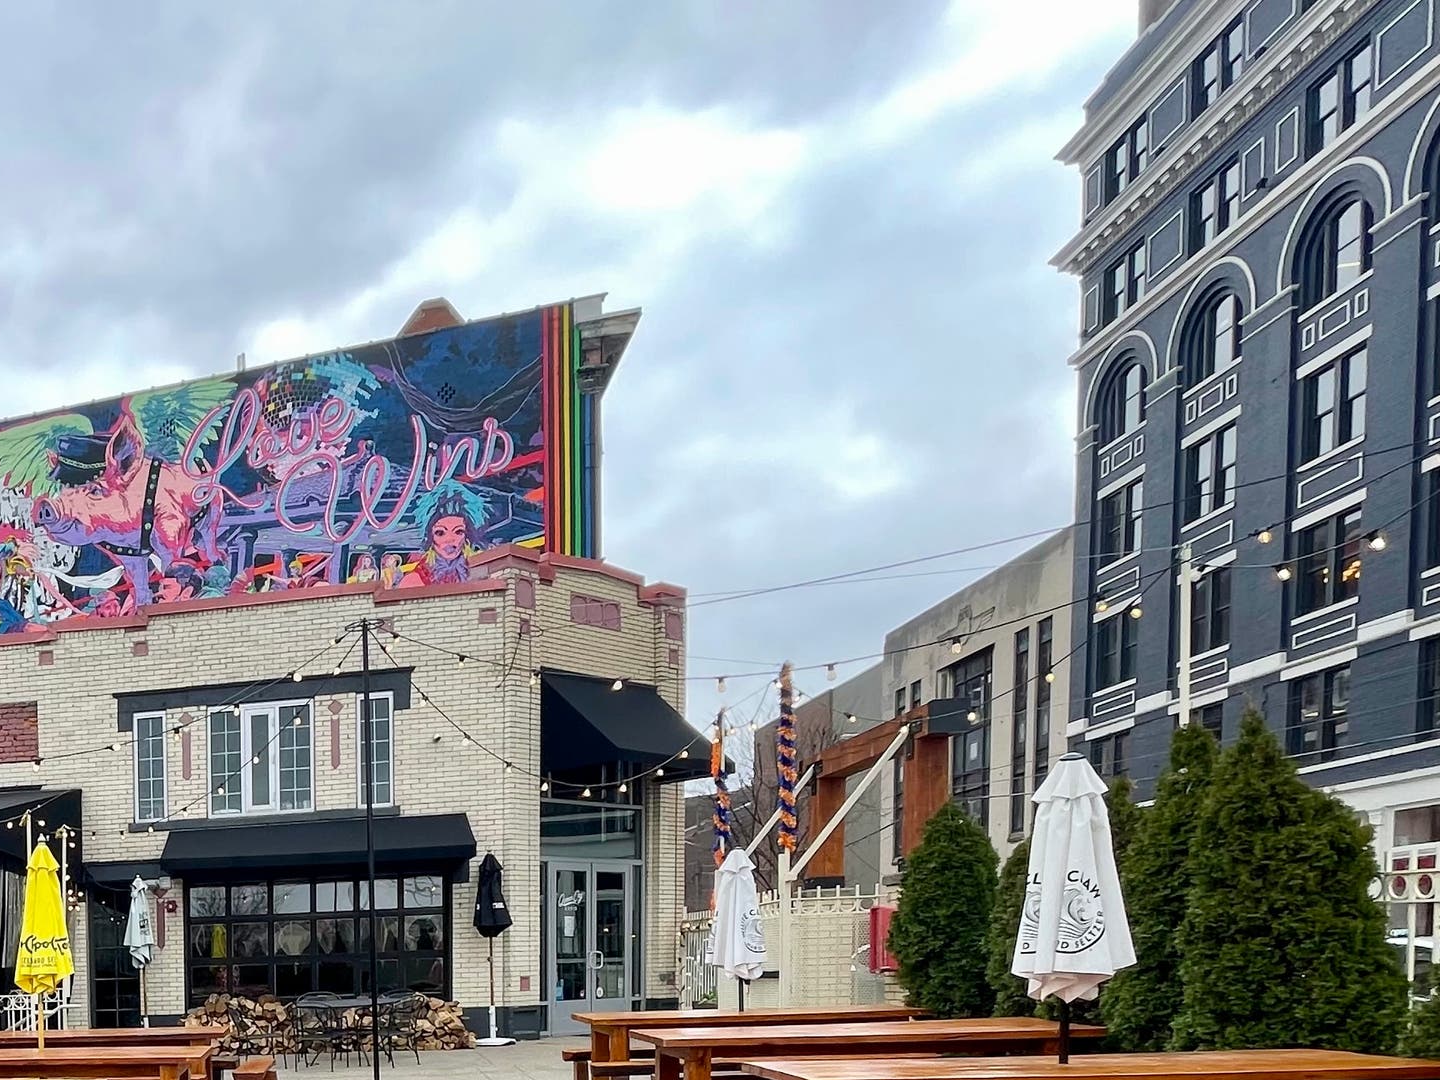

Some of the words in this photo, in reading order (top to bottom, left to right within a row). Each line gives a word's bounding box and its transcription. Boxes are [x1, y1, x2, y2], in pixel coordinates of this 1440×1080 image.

[182, 387, 357, 509] Love
[275, 413, 515, 543] Wins
[1074, 910, 1104, 949] SELTZER
